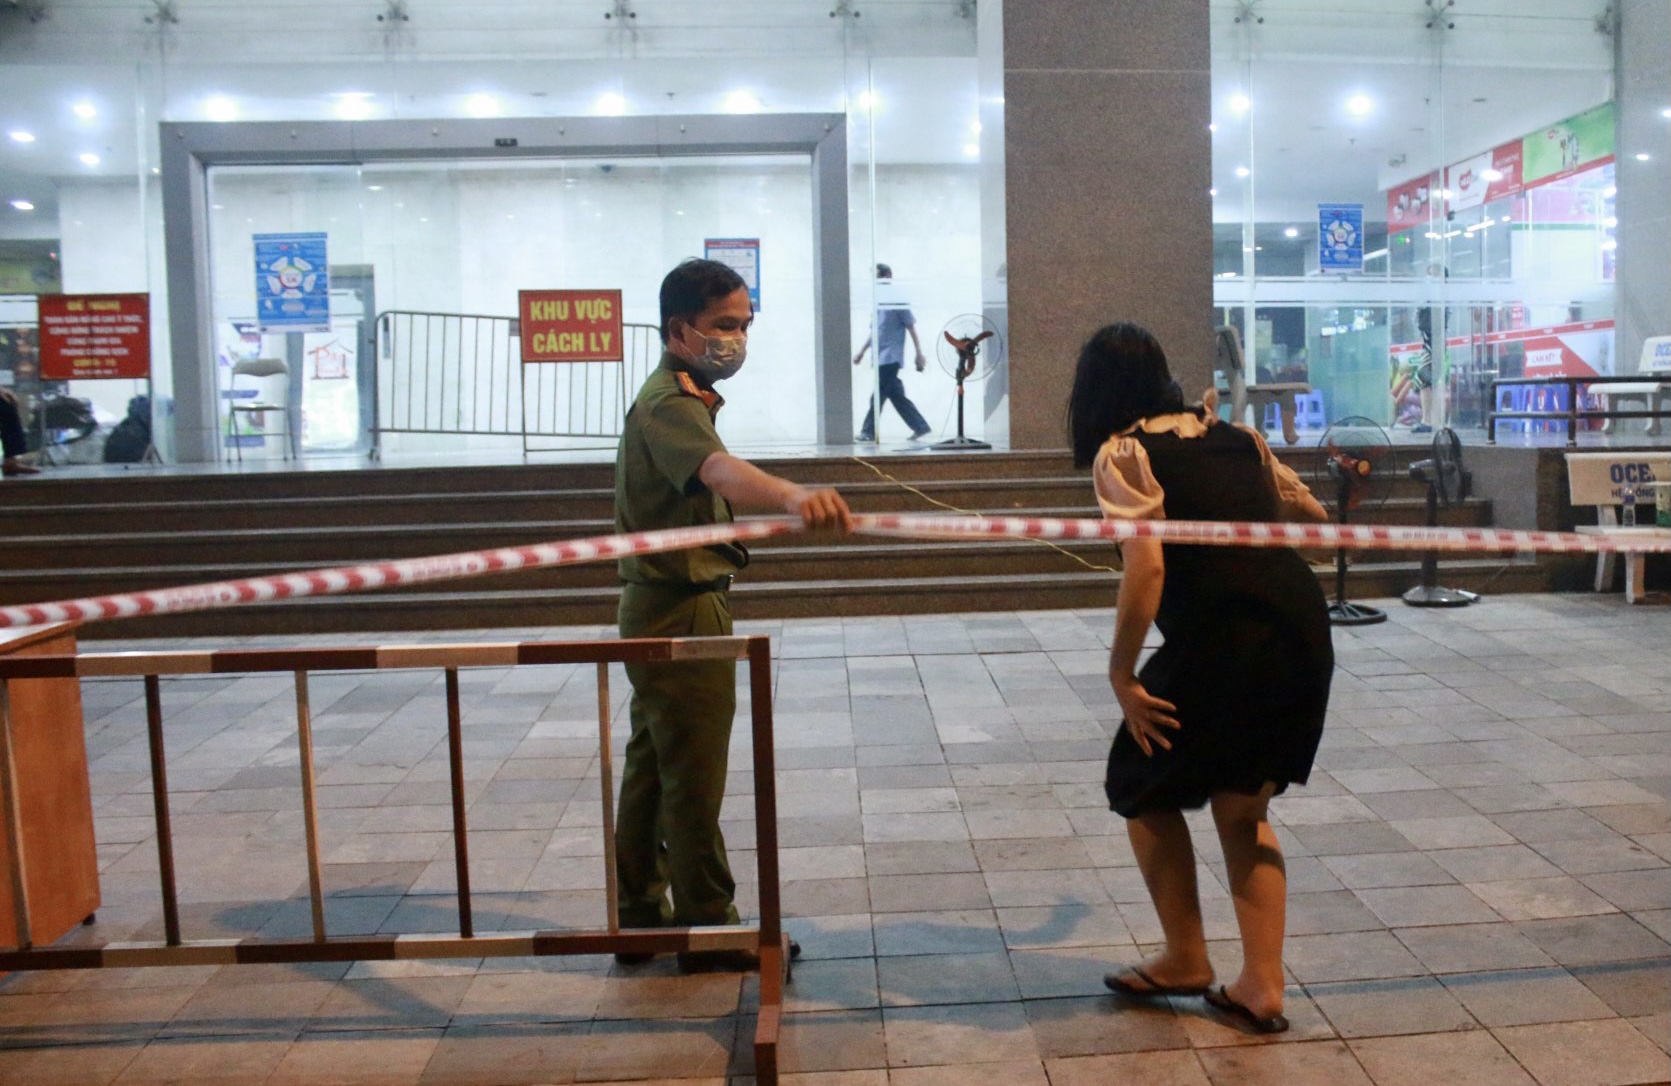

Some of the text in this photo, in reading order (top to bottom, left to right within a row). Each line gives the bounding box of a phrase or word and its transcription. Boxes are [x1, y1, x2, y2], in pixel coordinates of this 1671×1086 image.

[530, 297, 612, 324] KHU VỰC
[533, 329, 612, 354] CÁCH LY
